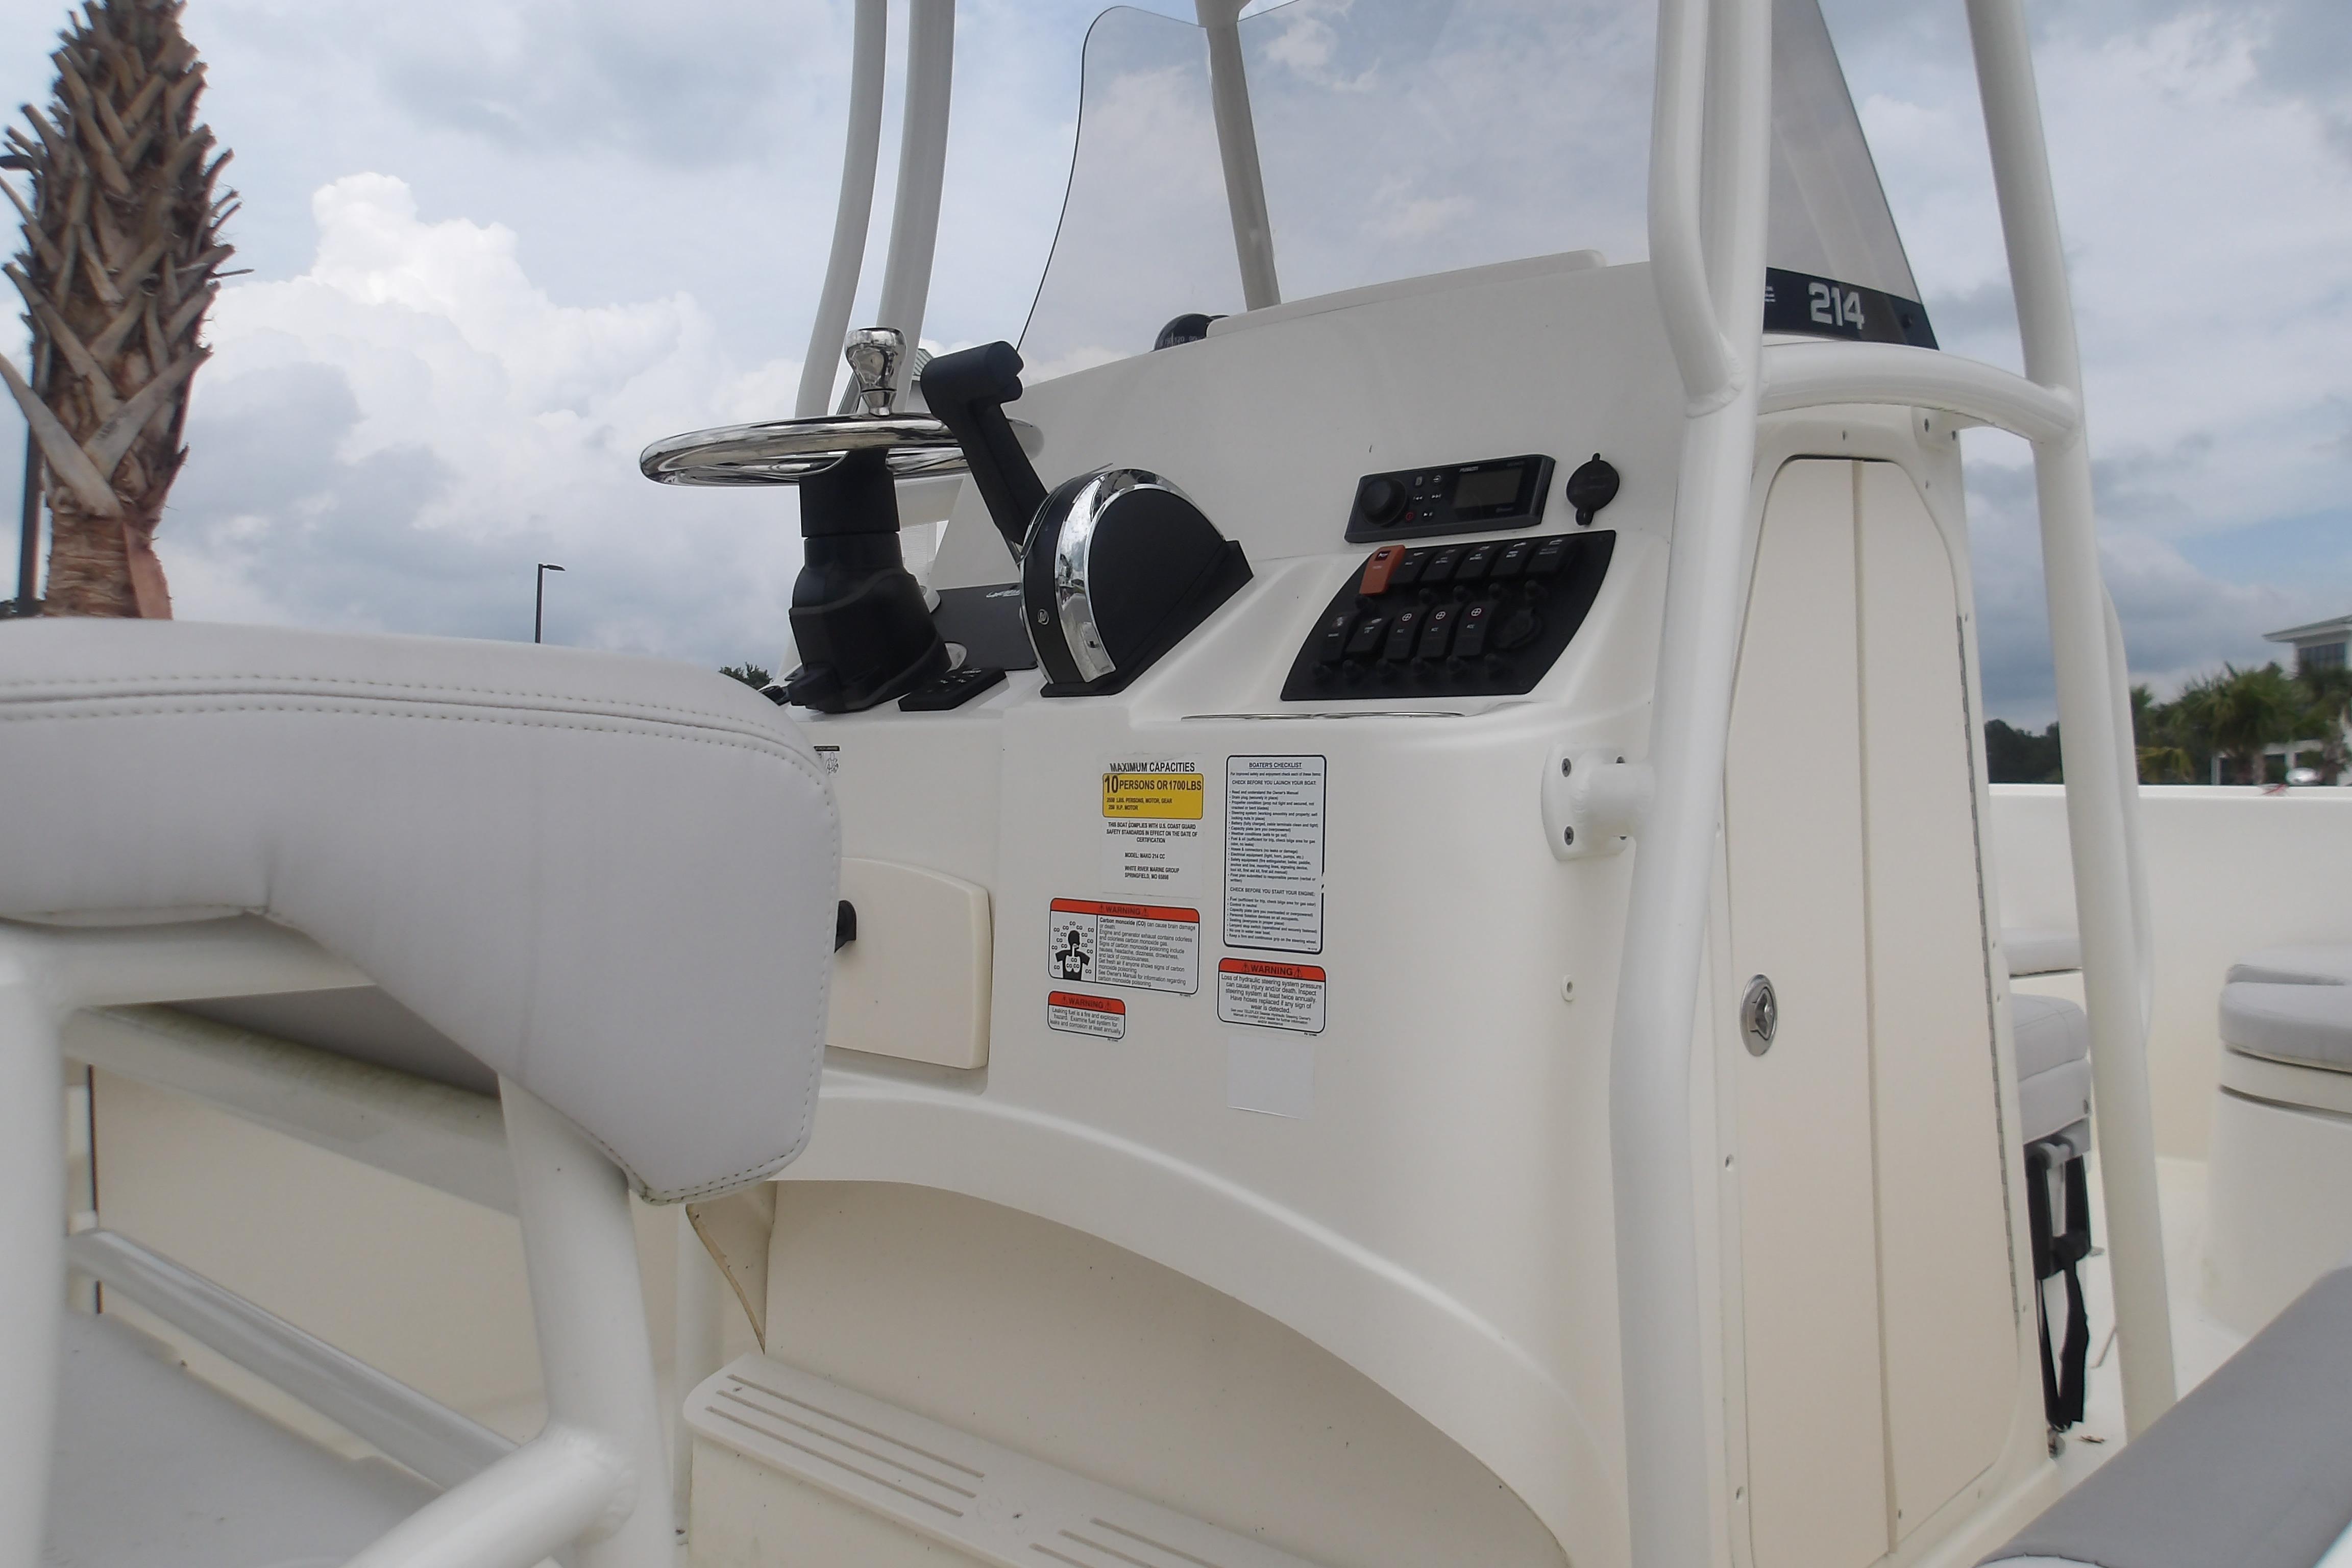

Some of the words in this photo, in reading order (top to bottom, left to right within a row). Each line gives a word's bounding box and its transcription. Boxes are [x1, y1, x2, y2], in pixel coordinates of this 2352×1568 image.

[1808, 282, 1865, 330] 214
[1110, 763, 1147, 772] MAXIMUM
[1149, 762, 1195, 772] CAPACITIES
[1105, 775, 1119, 793] 10
[1119, 780, 1155, 790] PERSONS
[1157, 780, 1168, 790] OR
[1169, 780, 1185, 790] 1700
[1186, 780, 1202, 790] LBS
[1106, 906, 1140, 915] WARNING
[1251, 965, 1293, 975] WARNING
[1069, 998, 1104, 1008] WARNING
